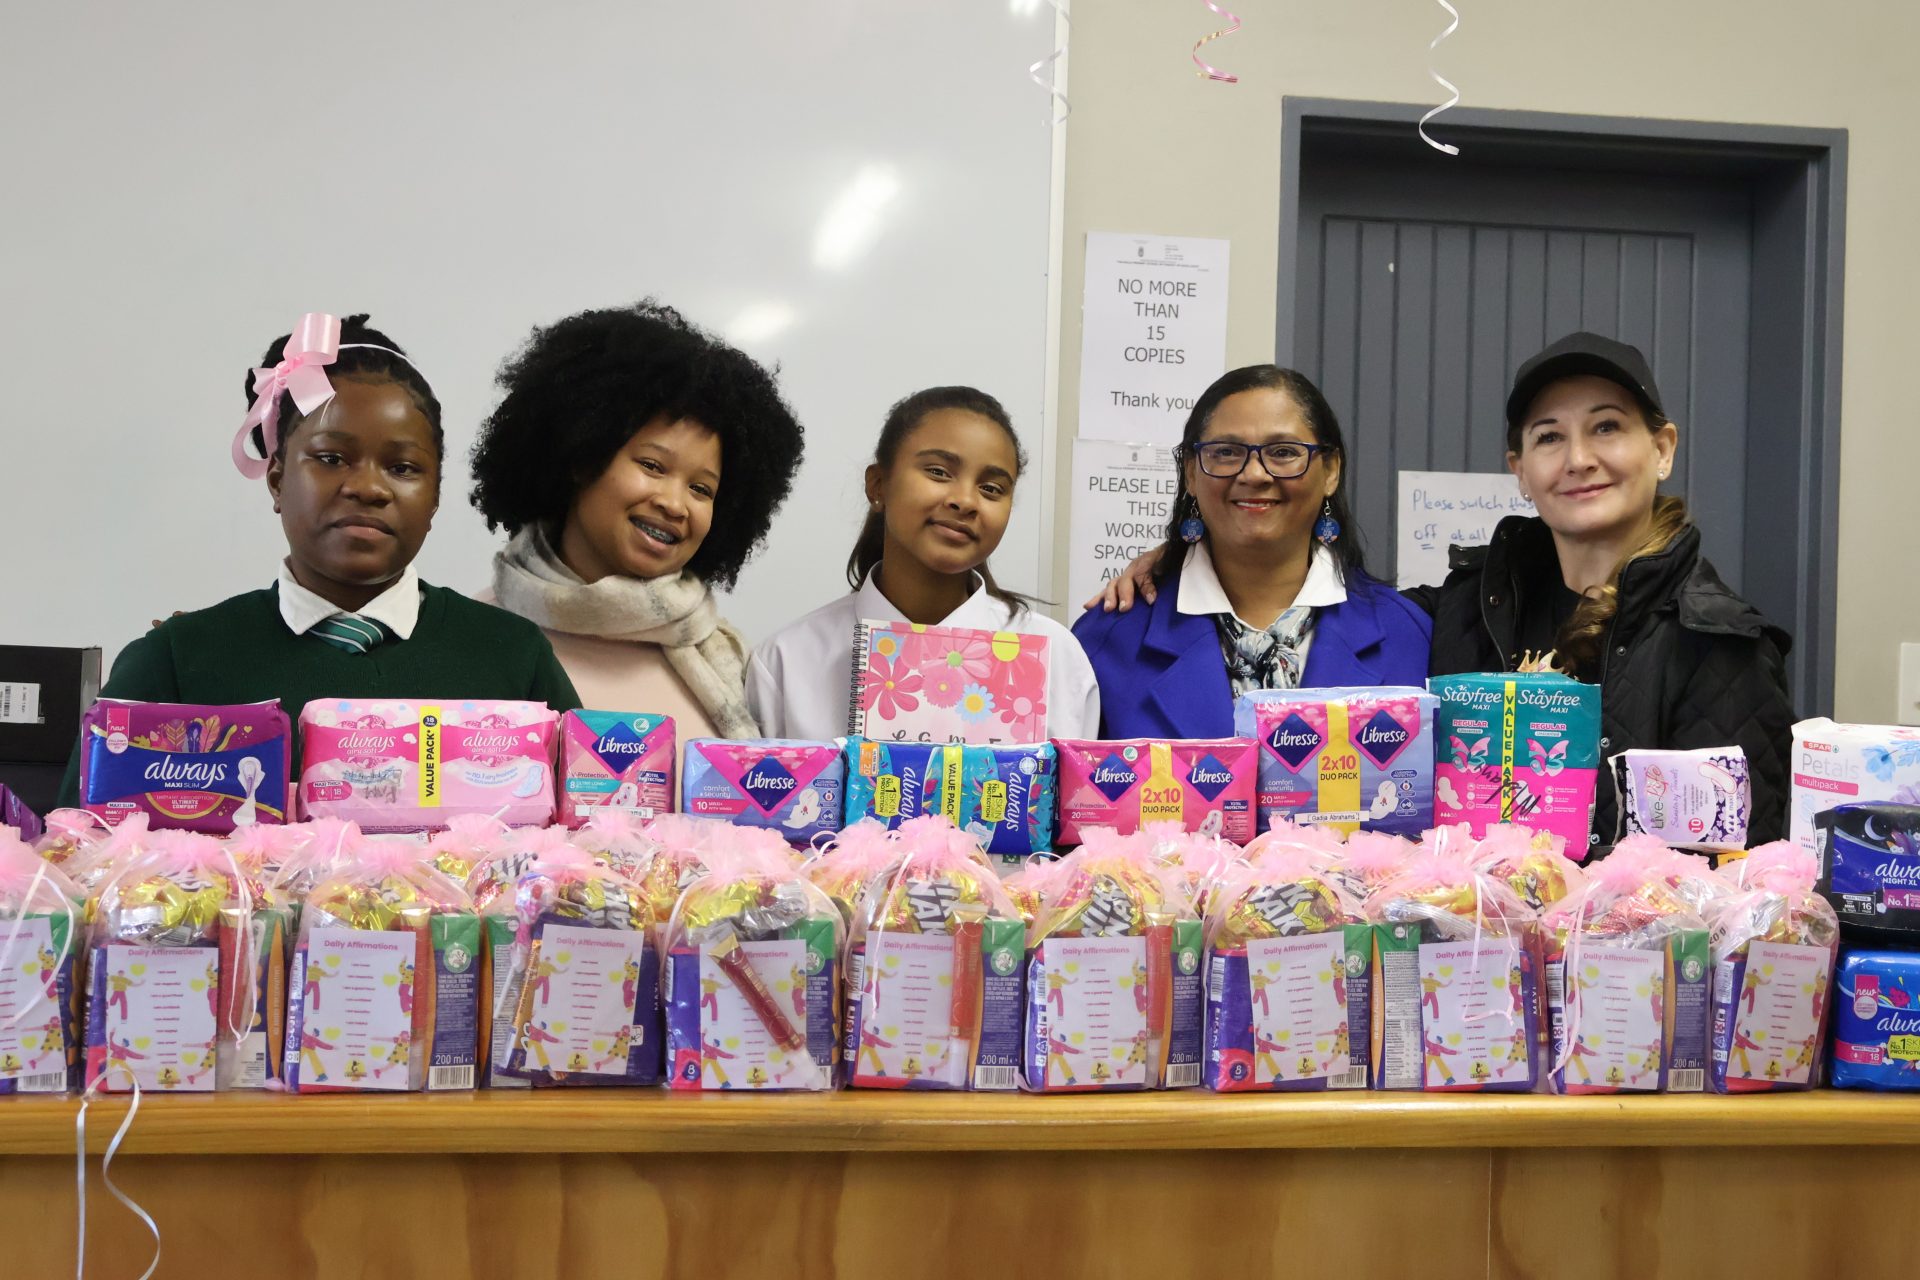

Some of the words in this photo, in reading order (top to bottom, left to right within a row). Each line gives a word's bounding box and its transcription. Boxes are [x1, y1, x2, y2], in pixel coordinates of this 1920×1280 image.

[1118, 278, 1143, 294] NO
[1149, 280, 1197, 297] MORE
[1134, 302, 1179, 319] THAN
[1147, 326, 1166, 341] 15
[1124, 347, 1185, 364] COPIES
[1111, 391, 1160, 408] Thank
[1166, 397, 1194, 412] you
[1089, 476, 1150, 494] PLEASE
[1413, 488, 1455, 511] Please
[1459, 495, 1504, 511] switch
[1127, 501, 1167, 517] THIS
[1450, 529, 1465, 541] at
[1469, 528, 1488, 541] all
[1094, 544, 1147, 561] SPACE
[1441, 686, 1503, 703] Stayfree
[1517, 689, 1580, 708] Stayfree
[1453, 720, 1488, 728] REGULAR
[1504, 695, 1515, 750] VALUE
[1530, 722, 1567, 731] REGULAR
[462, 731, 520, 752] always
[1272, 729, 1319, 748] Libresse
[1361, 726, 1406, 745] Libresse
[337, 731, 397, 755] always
[425, 733, 435, 759] PACK
[598, 736, 646, 754] Libresse
[1808, 742, 1832, 752] SPAR
[863, 764, 871, 774] 20
[1321, 754, 1357, 771] 2x10
[1802, 753, 1859, 780] Petals
[144, 754, 228, 789] always
[947, 762, 957, 793] VALUE
[1094, 767, 1135, 784] Libresse
[1191, 767, 1231, 784] Libresse
[1320, 773, 1337, 781] DUO
[1337, 772, 1358, 780] PACK
[425, 762, 435, 797] VALUE
[570, 781, 576, 789] 8
[745, 771, 795, 790] Libresse
[1801, 777, 1840, 791] multipack
[1003, 772, 1027, 832] always
[1142, 787, 1182, 804] 2x10
[1261, 796, 1273, 804] 20
[696, 801, 708, 810] 10
[946, 793, 955, 815] PACK
[1142, 805, 1159, 813] DUO
[1160, 805, 1180, 814] PACK
[1071, 811, 1081, 819] 20
[1650, 801, 1665, 829] Live
[1690, 819, 1701, 832] 10
[1882, 877, 1907, 886] NIGHT
[1862, 902, 1872, 911] 16
[1887, 897, 1903, 907] No.
[1903, 893, 1910, 907] 1
[324, 940, 346, 950] Daily
[347, 940, 398, 951] Affirmations
[556, 937, 577, 946] Daily
[577, 938, 625, 949] Affirmations
[1263, 945, 1282, 956] Daily
[1283, 942, 1328, 953] Affirmations
[128, 948, 149, 958] Daily
[151, 948, 204, 956] Affirmations
[1062, 947, 1082, 956] Daily
[1083, 946, 1130, 955] Affirmations
[1435, 951, 1455, 960] Daily
[1456, 948, 1504, 958] Affirations
[1583, 952, 1603, 961] Daily
[1604, 953, 1649, 964] Affirmations
[1763, 950, 1778, 960] Daily
[1779, 951, 1817, 962] Affirmations
[1856, 988, 1877, 996] new
[1900, 1038, 1906, 1050] 1
[435, 1054, 452, 1065] 200
[453, 1053, 464, 1065] ml
[981, 1054, 997, 1065] 200
[998, 1053, 1009, 1065] ml
[1172, 1052, 1185, 1063] 200
[1185, 1051, 1193, 1062] ml
[1673, 1058, 1687, 1068] 200
[1688, 1057, 1697, 1068] ml
[688, 1064, 695, 1075] 8
[1235, 1064, 1242, 1075] 8
